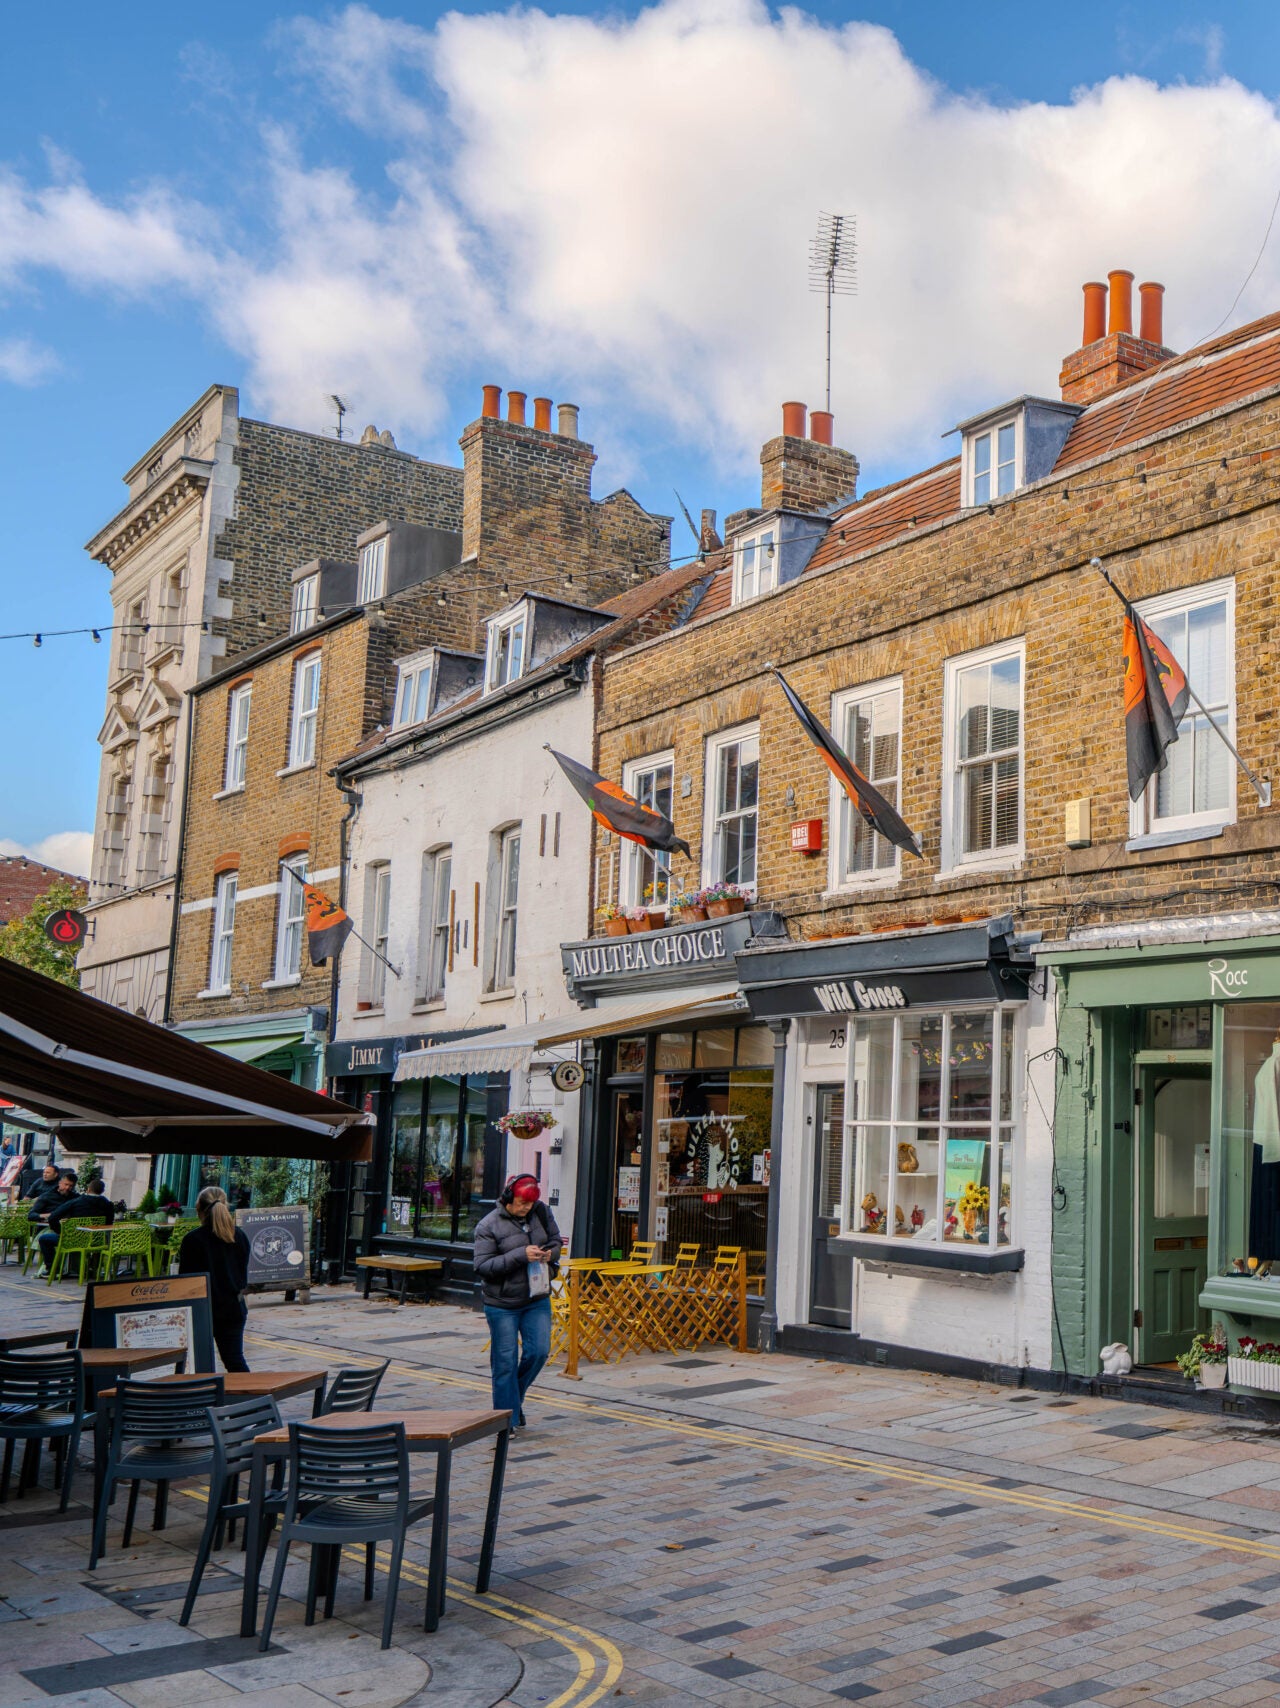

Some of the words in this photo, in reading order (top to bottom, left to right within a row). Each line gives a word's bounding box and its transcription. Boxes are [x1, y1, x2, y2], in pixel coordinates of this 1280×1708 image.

[792, 827, 807, 839] ABEL
[572, 941, 649, 977] MULTEA
[651, 928, 726, 966] CHOICE
[813, 981, 856, 1012] Wild
[853, 980, 906, 1009] Goose
[829, 1029, 845, 1049] 25
[686, 1110, 716, 1177] MULTEA
[720, 1114, 740, 1191] CHOICE
